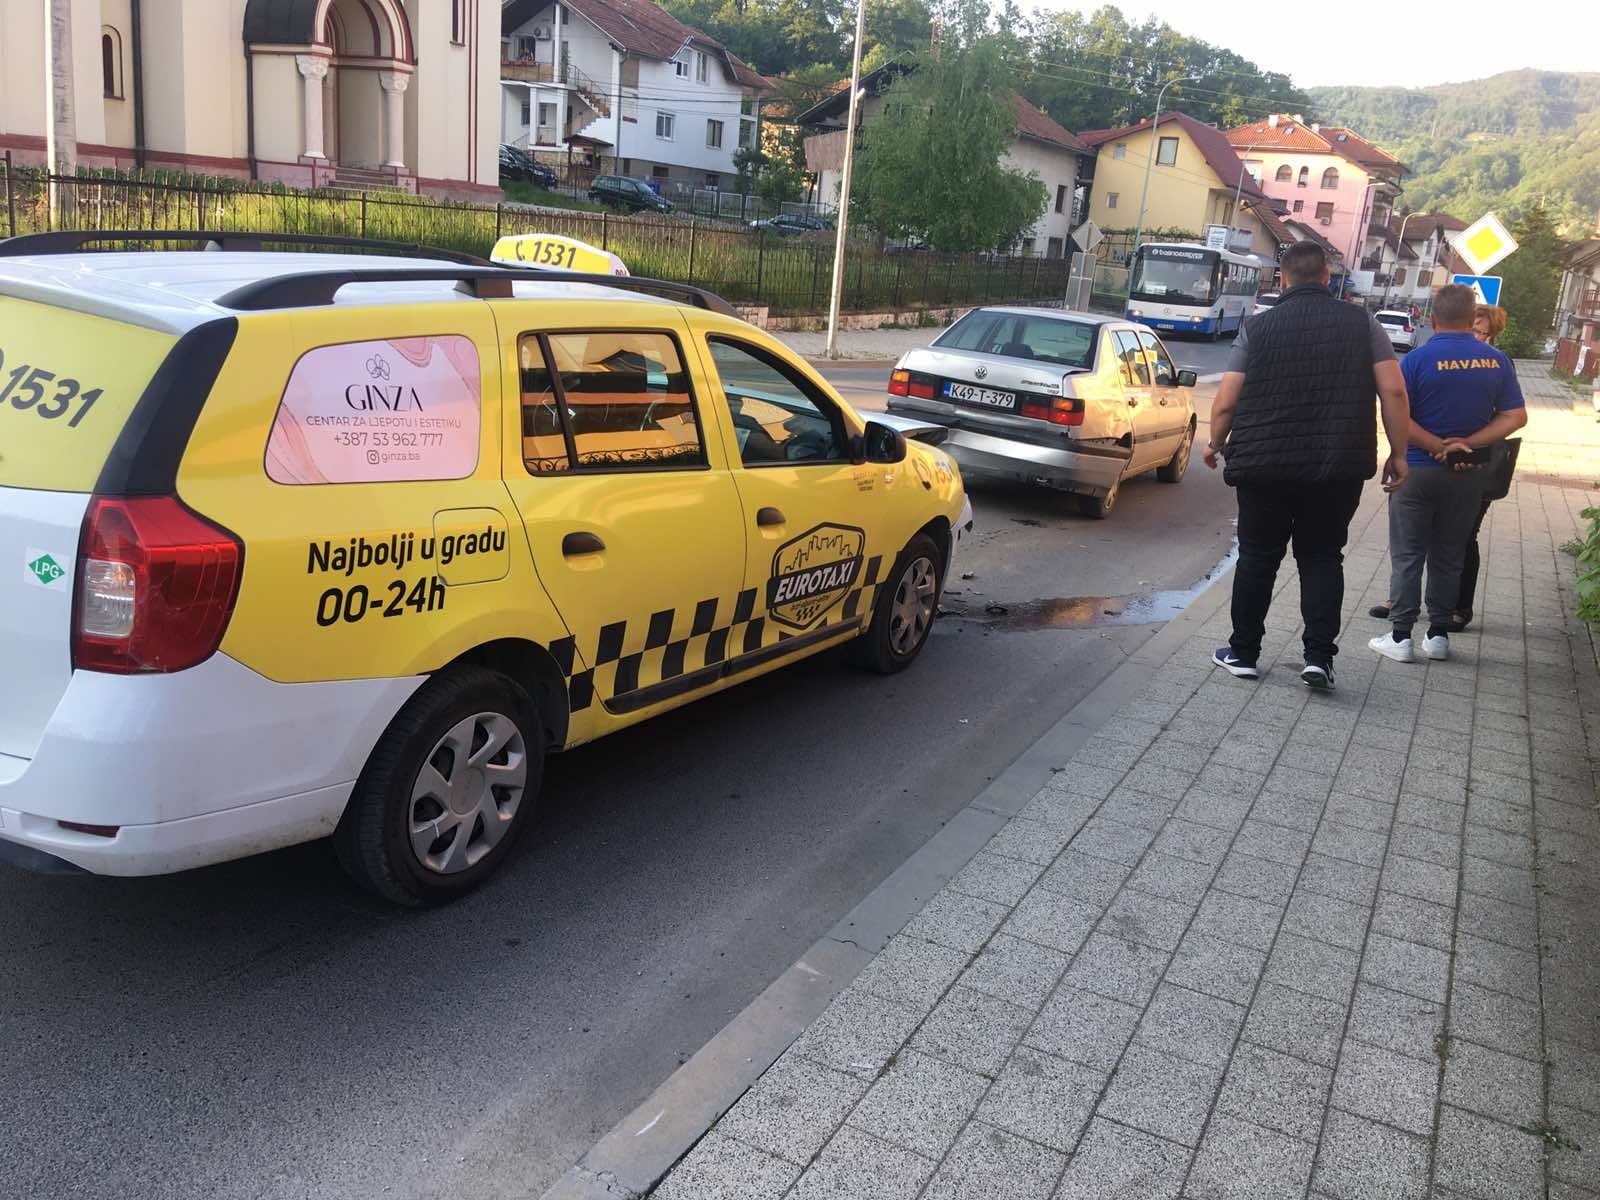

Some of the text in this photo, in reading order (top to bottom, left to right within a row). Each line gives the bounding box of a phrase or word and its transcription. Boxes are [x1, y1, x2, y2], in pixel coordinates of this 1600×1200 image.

[533, 241, 577, 269] 1531
[1437, 358, 1501, 371] HAVANA
[0, 364, 105, 428] 1531
[345, 383, 424, 412] GINZA
[951, 382, 1014, 408] K49-T-379
[306, 415, 350, 426] CENTAR
[352, 417, 366, 427] ZA
[369, 417, 413, 428] LJEPOTU
[419, 418, 462, 429] ESTETIKU
[334, 431, 444, 446] +387 53 962 777
[307, 525, 506, 576] Najbolji u gradu
[34, 559, 60, 579] LPG
[774, 560, 855, 604] EUROTAXI
[316, 575, 447, 627] 00-24h
